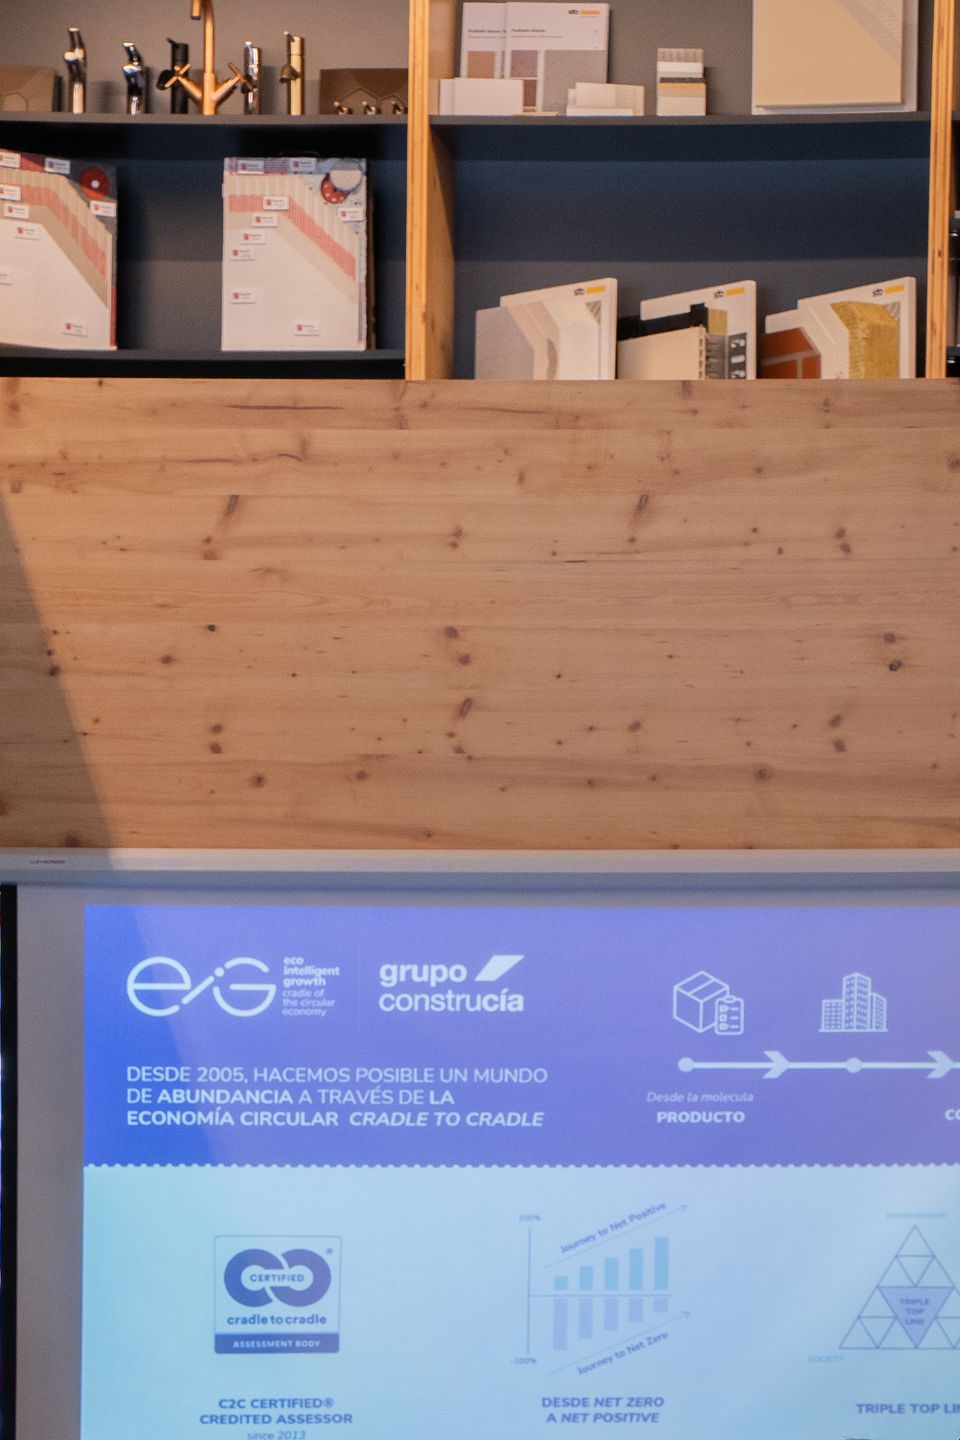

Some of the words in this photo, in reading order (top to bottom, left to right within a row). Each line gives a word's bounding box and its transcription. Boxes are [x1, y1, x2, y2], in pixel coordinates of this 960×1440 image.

[283, 957, 304, 965] eco
[283, 965, 340, 977] intelligent
[379, 964, 468, 988] grupo
[283, 976, 326, 988] growth
[378, 987, 525, 1012] construcía
[282, 1008, 327, 1017] economy
[127, 1066, 191, 1082] DESDE
[197, 1067, 249, 1084] 2005,
[253, 1067, 351, 1083] HACEMOS
[356, 1067, 435, 1083] POSIBLE
[440, 1068, 468, 1083] UN
[474, 1068, 548, 1083] MUNDO
[127, 1088, 152, 1104] DE
[157, 1089, 294, 1104] ABUNDANCIA
[298, 1089, 313, 1104] A
[317, 1086, 394, 1105] TRAVÉS
[399, 1089, 425, 1105] DE
[429, 1090, 455, 1105] LA
[647, 1091, 685, 1102] Desde
[687, 1092, 699, 1102] la
[127, 1107, 235, 1126] ECONOMÍA
[240, 1111, 339, 1126] CIRCULAR
[349, 1111, 429, 1126] CRADLE
[434, 1112, 460, 1126] TO
[466, 1112, 544, 1127] CRADLE
[657, 1111, 745, 1123] PRODUCTO
[561, 1233, 597, 1254] Journey
[598, 1228, 609, 1237] to
[609, 1218, 628, 1232] Net
[628, 1202, 667, 1223] Positive
[250, 1273, 305, 1282] CERTIFIED
[227, 1314, 269, 1325] cradle
[270, 1315, 284, 1325] to
[285, 1314, 327, 1325] cradle
[233, 1340, 293, 1349] ASSESSMENT
[295, 1340, 321, 1348] BODY
[578, 1356, 614, 1375] Journey
[614, 1349, 626, 1359] to
[627, 1341, 646, 1355] Net
[646, 1332, 669, 1346] Zero
[218, 1398, 247, 1409] C2C
[542, 1397, 590, 1408] DESDE
[593, 1396, 623, 1408] NET
[626, 1396, 664, 1407] ZERO
[856, 1403, 906, 1414] TRIPLE
[910, 1403, 940, 1414] TOP
[200, 1414, 272, 1425] CREDITED
[276, 1413, 353, 1425] ASSESSOR
[546, 1412, 557, 1423] A
[560, 1412, 590, 1423] NET
[592, 1412, 660, 1423] POSITIVE
[247, 1431, 275, 1440] since
[277, 1430, 306, 1440] 2013
